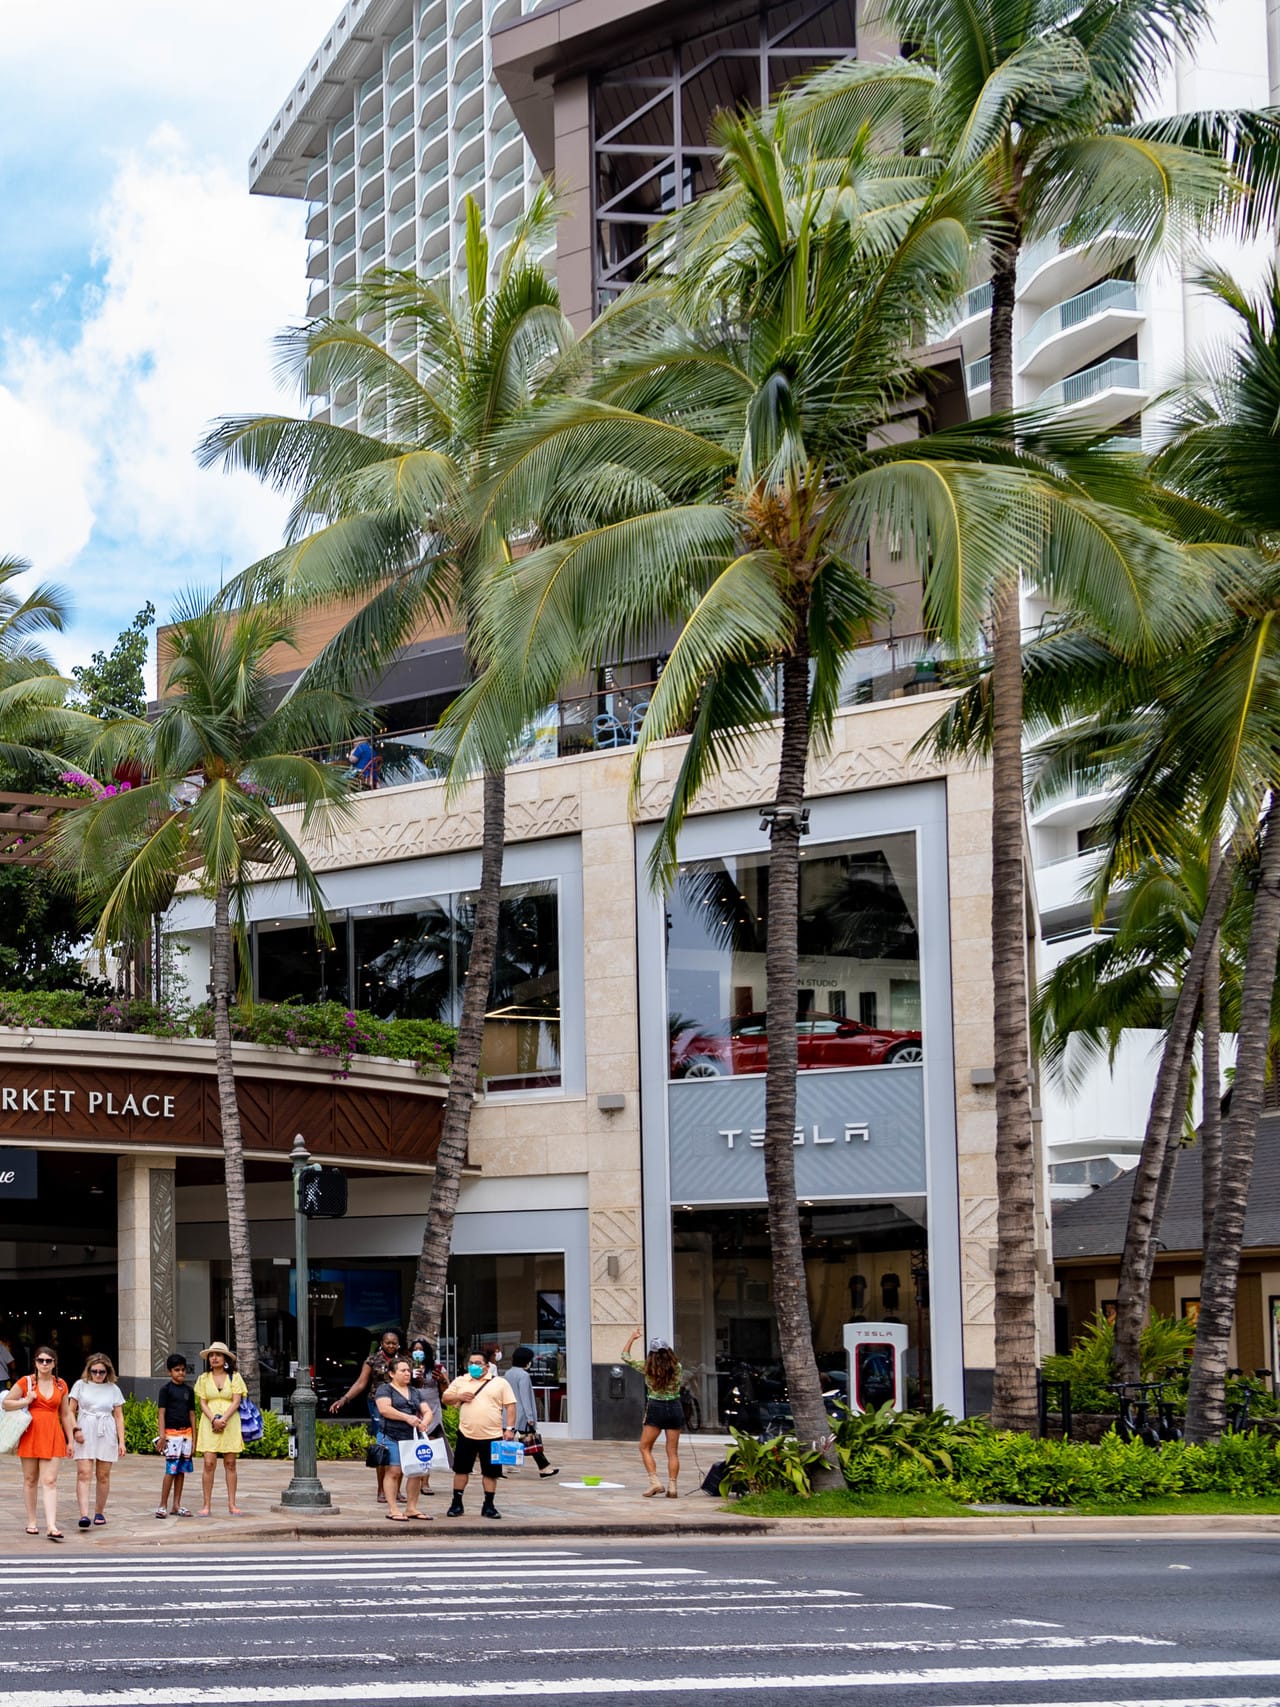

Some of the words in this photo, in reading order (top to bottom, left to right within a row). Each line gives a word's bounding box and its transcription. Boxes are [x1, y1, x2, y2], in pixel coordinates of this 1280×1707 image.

[807, 979, 838, 988] STUDIO
[88, 1091, 175, 1118] PLACE
[417, 1448, 432, 1456] ABC
